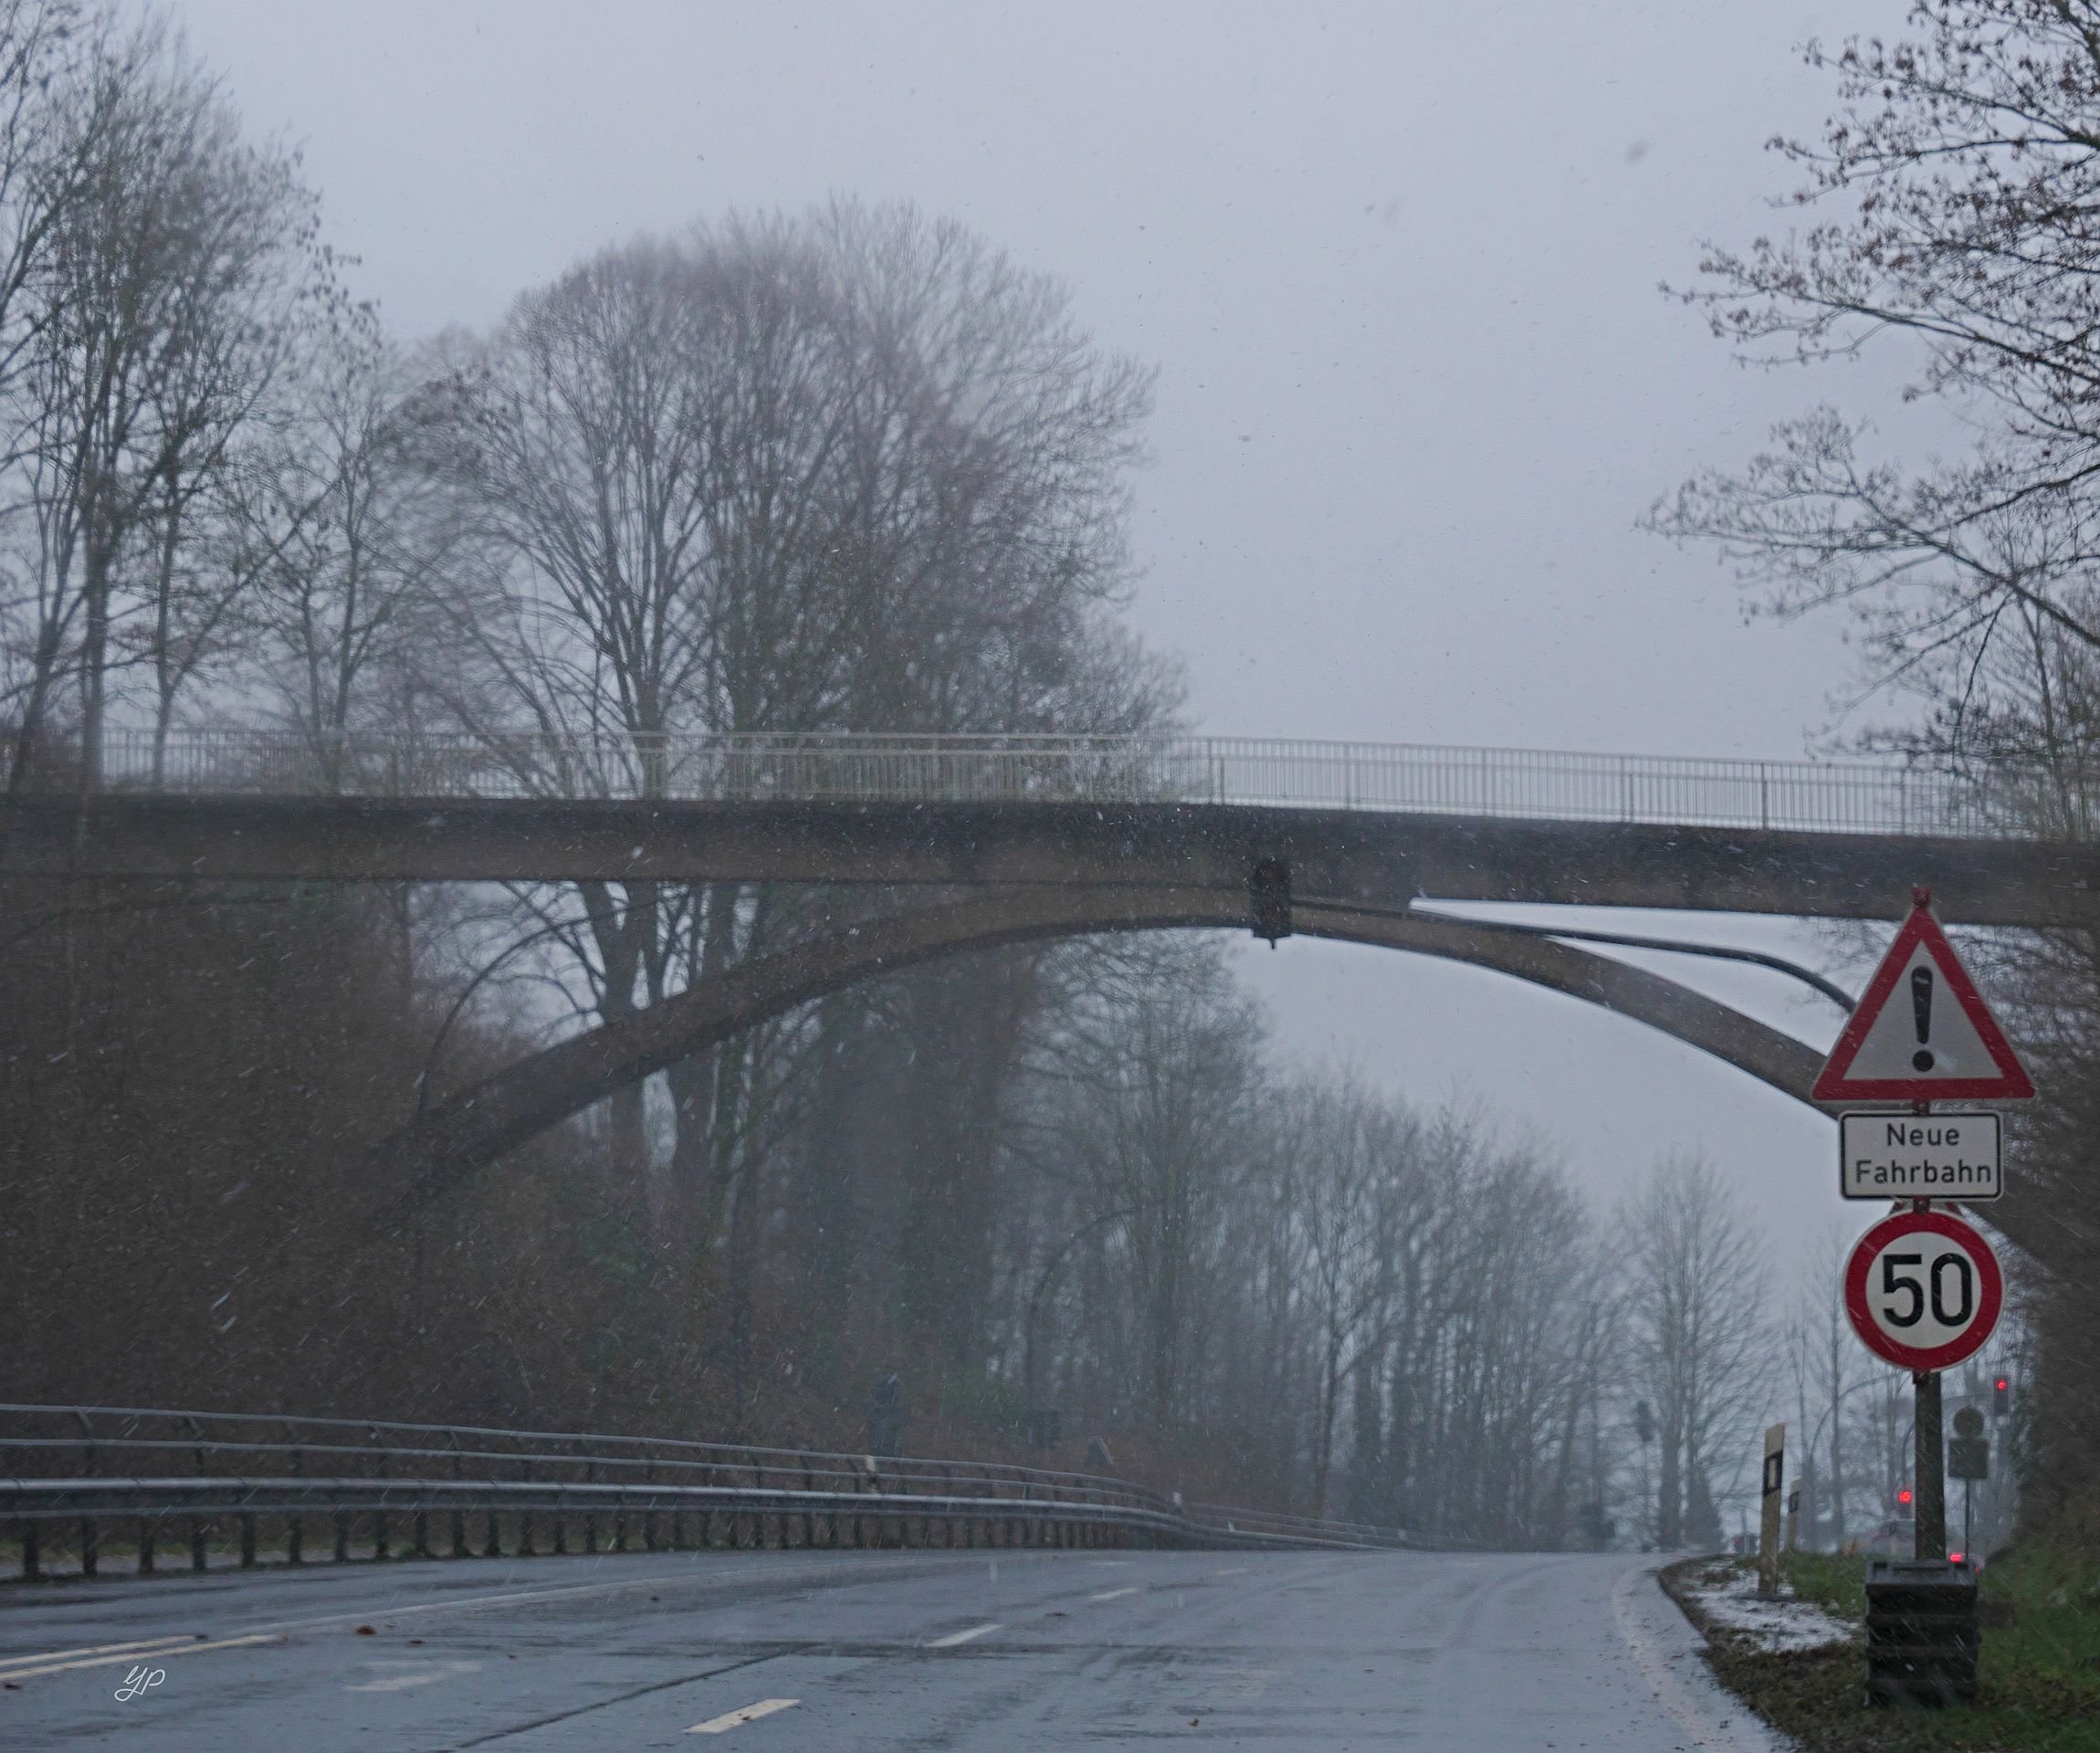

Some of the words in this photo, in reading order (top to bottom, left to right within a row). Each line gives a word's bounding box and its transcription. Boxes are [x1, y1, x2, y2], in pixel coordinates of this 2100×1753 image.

[1886, 1123, 1959, 1147] Neue
[1856, 1160, 1992, 1184] Fahrbahn
[1883, 1253, 1973, 1328] 50
